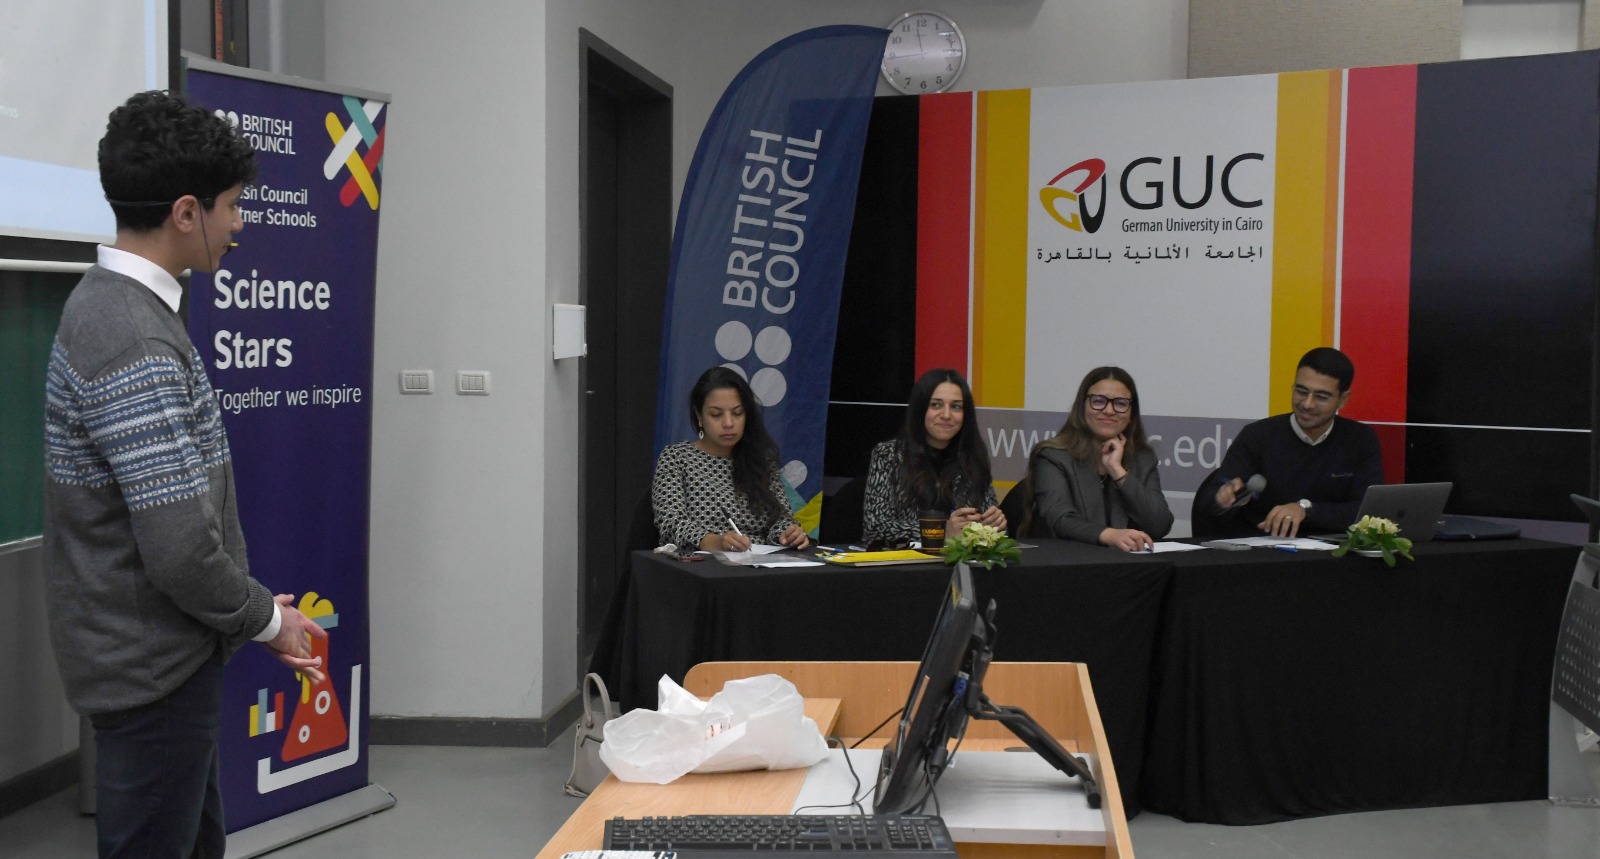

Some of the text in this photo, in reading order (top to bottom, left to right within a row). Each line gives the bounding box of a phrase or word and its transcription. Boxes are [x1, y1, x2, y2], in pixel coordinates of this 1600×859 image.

[916, 19, 927, 27] 12
[892, 36, 902, 44] 10
[905, 77, 911, 85] 7
[920, 80, 927, 89] 6
[935, 76, 942, 84] 5
[242, 113, 293, 137] BRITISH
[1120, 152, 1265, 210] GUC
[260, 184, 308, 205] Council
[239, 206, 317, 228] tner Schools
[722, 129, 783, 308] BRITISH
[761, 129, 823, 315] COUNCIL
[1121, 216, 1263, 234] German University in Cairo
[1037, 243, 1262, 264] الجامعة الألمانية بالقاهرة
[214, 269, 331, 310] Science
[214, 329, 293, 370] Stars
[214, 383, 362, 415] Together we inspire
